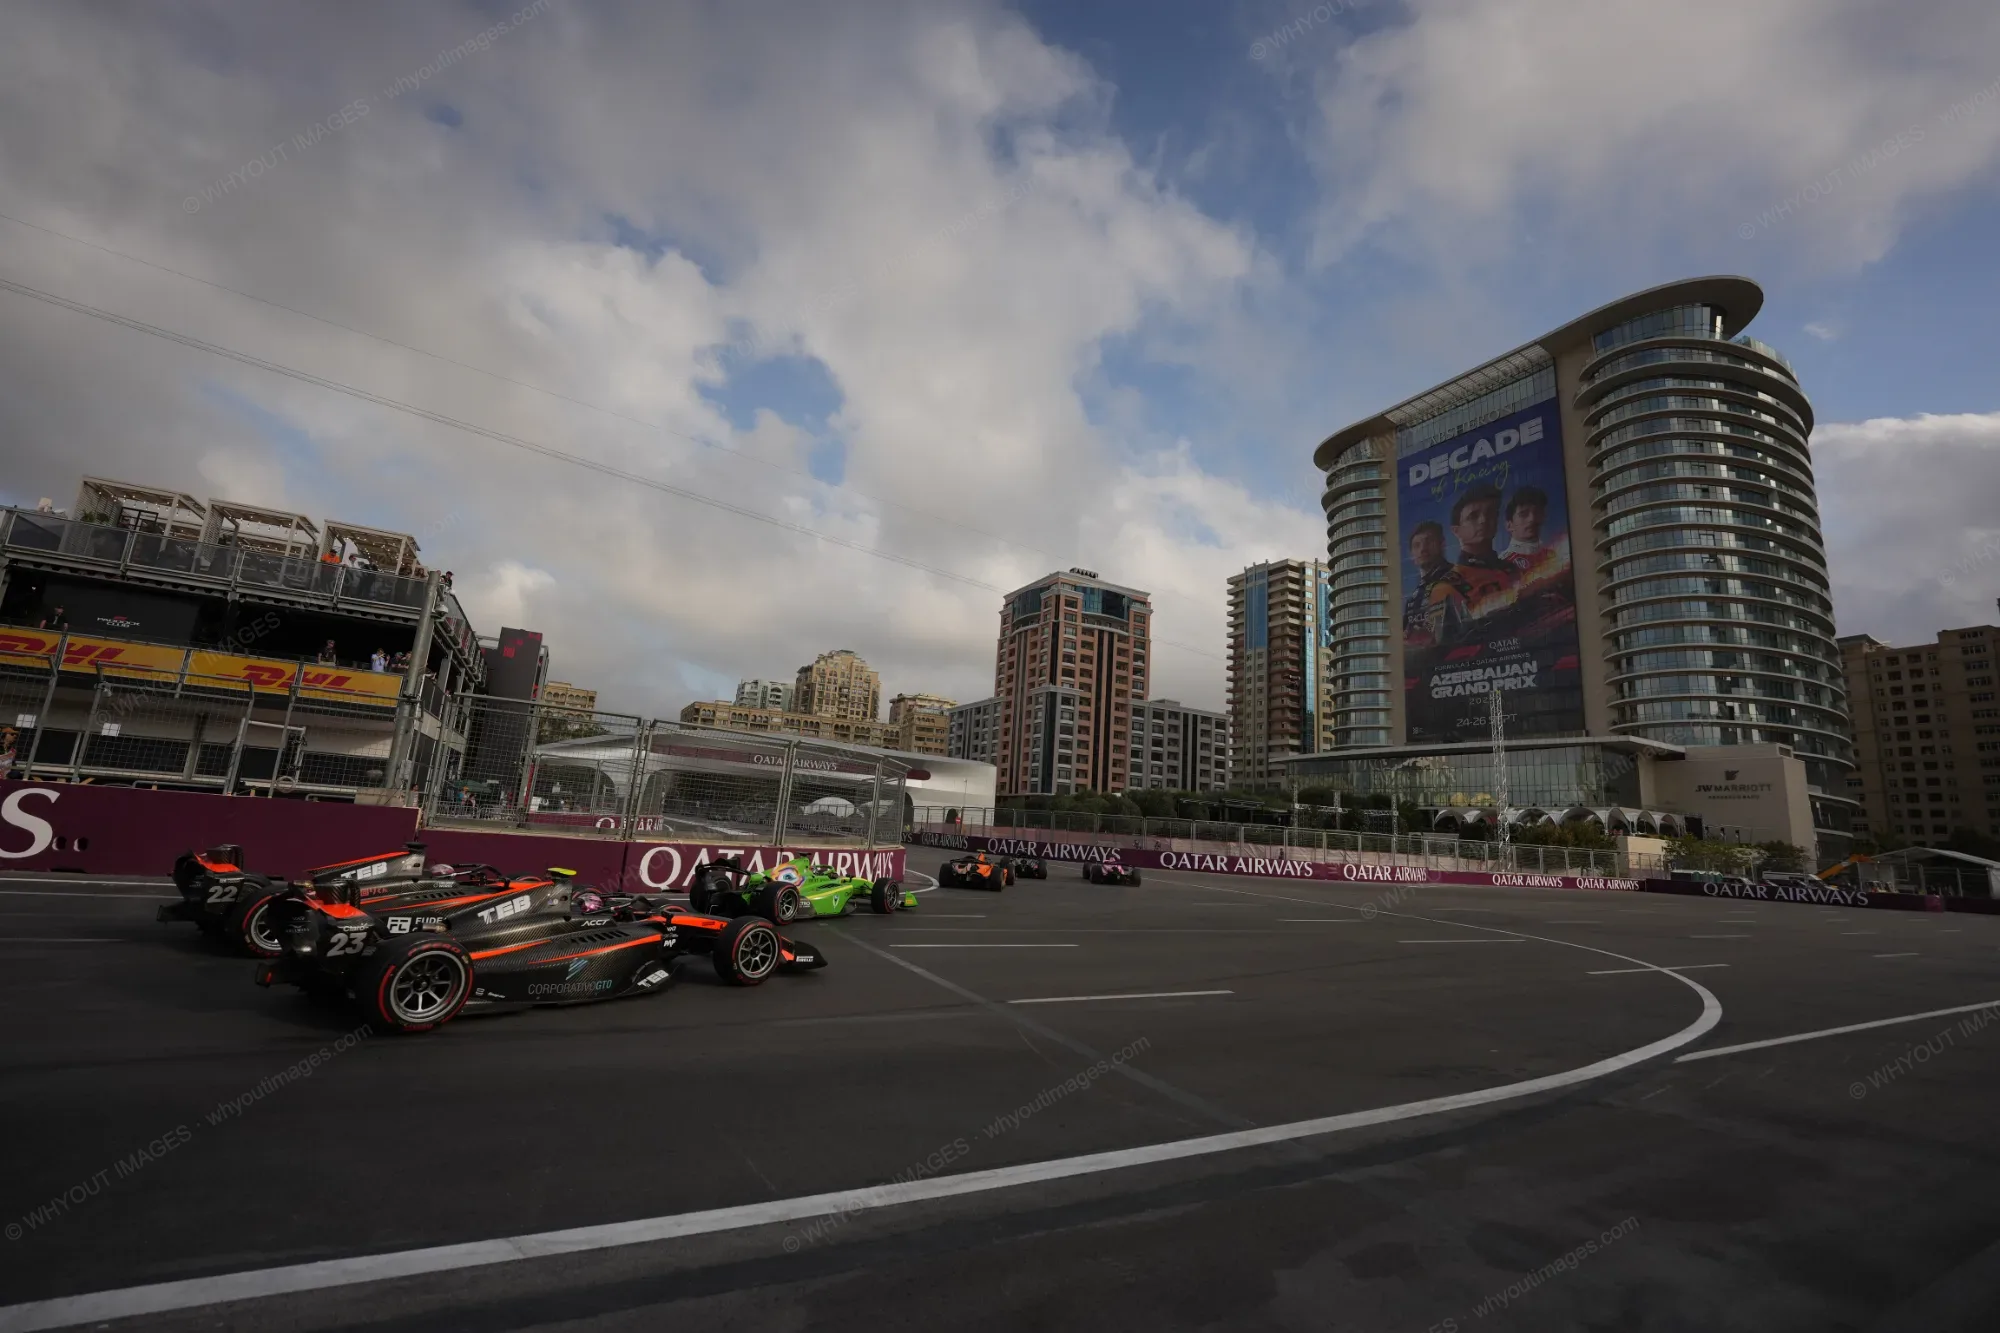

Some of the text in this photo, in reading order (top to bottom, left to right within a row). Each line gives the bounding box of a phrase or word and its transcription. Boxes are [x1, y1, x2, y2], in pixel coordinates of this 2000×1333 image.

[1409, 416, 1544, 487] DECADE
[1452, 460, 1511, 492] Racing
[0, 634, 133, 667] DHL
[1489, 637, 1520, 650] QATAR
[242, 664, 356, 693] DHL
[1430, 660, 1538, 687] AZERBAIJAN
[1431, 675, 1539, 699] GRAND PRIX
[1469, 696, 1494, 705] 202
[1456, 713, 1518, 728] 24-26 SPT
[754, 754, 837, 771] QATA AIRWAYS
[1695, 783, 1774, 792] JW MARRIOTT
[0, 788, 60, 858] S
[921, 833, 968, 849] QATAR AIRWAYS
[987, 839, 1120, 862] QATAR AIRWAYS
[1160, 852, 1314, 877] QATAR AIRWAYS
[1343, 863, 1427, 882] QATAR AIRWAYS
[1492, 874, 1563, 888] QATAR AIRWAYS
[1576, 878, 1639, 891] QATAR AIRWAYS
[206, 885, 238, 903] 22
[1704, 881, 1868, 906] QATAR AIRWAYS
[326, 932, 367, 957] 23
